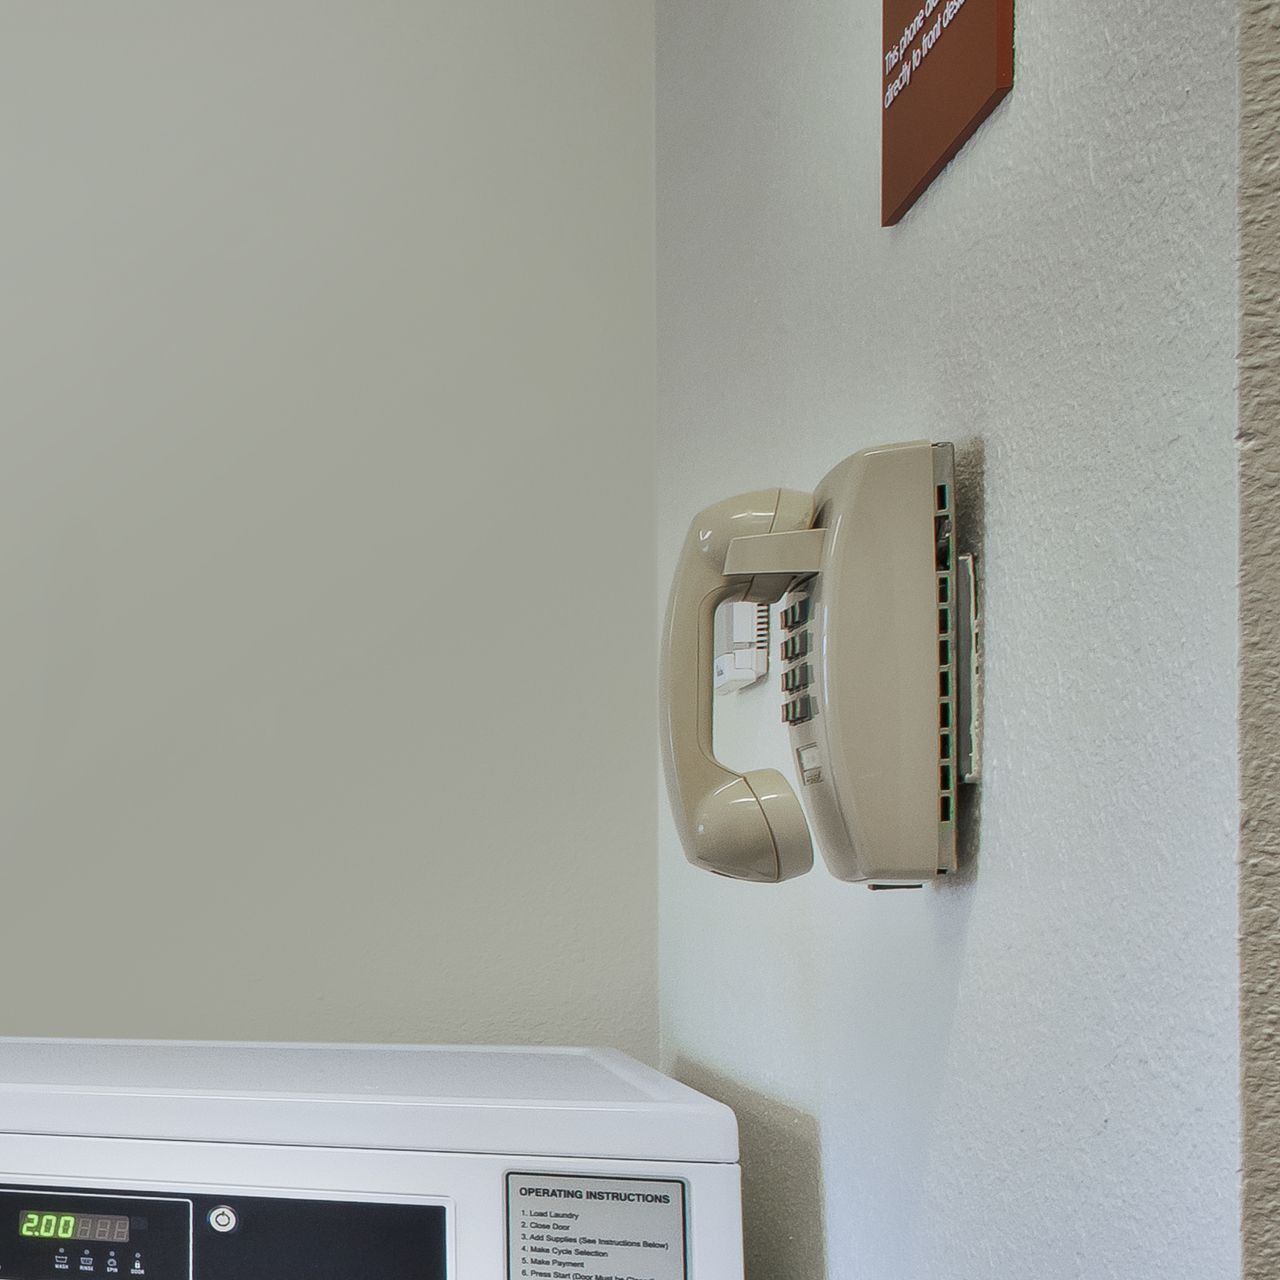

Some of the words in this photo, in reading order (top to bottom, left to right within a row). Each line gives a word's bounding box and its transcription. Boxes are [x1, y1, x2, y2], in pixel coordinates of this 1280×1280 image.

[885, 45, 898, 75] This
[900, 9, 924, 60] phone
[885, 61, 911, 108] directly
[912, 49, 920, 71] to
[923, 13, 941, 57] front
[943, 0, 965, 27] des
[520, 1187, 582, 1199] OPERATING
[586, 1191, 670, 1204] INSTRUCTIONS
[550, 1212, 579, 1220] Laundry
[22, 1214, 74, 1237] 2.00
[546, 1236, 577, 1244] Supplies
[579, 1237, 596, 1245] (See
[598, 1238, 640, 1247] Instructions
[643, 1241, 668, 1249] Below)
[552, 1247, 572, 1256] Cycle
[552, 1260, 584, 1269] Payment
[530, 1270, 551, 1278] Press
[572, 1273, 593, 1280] (Door
